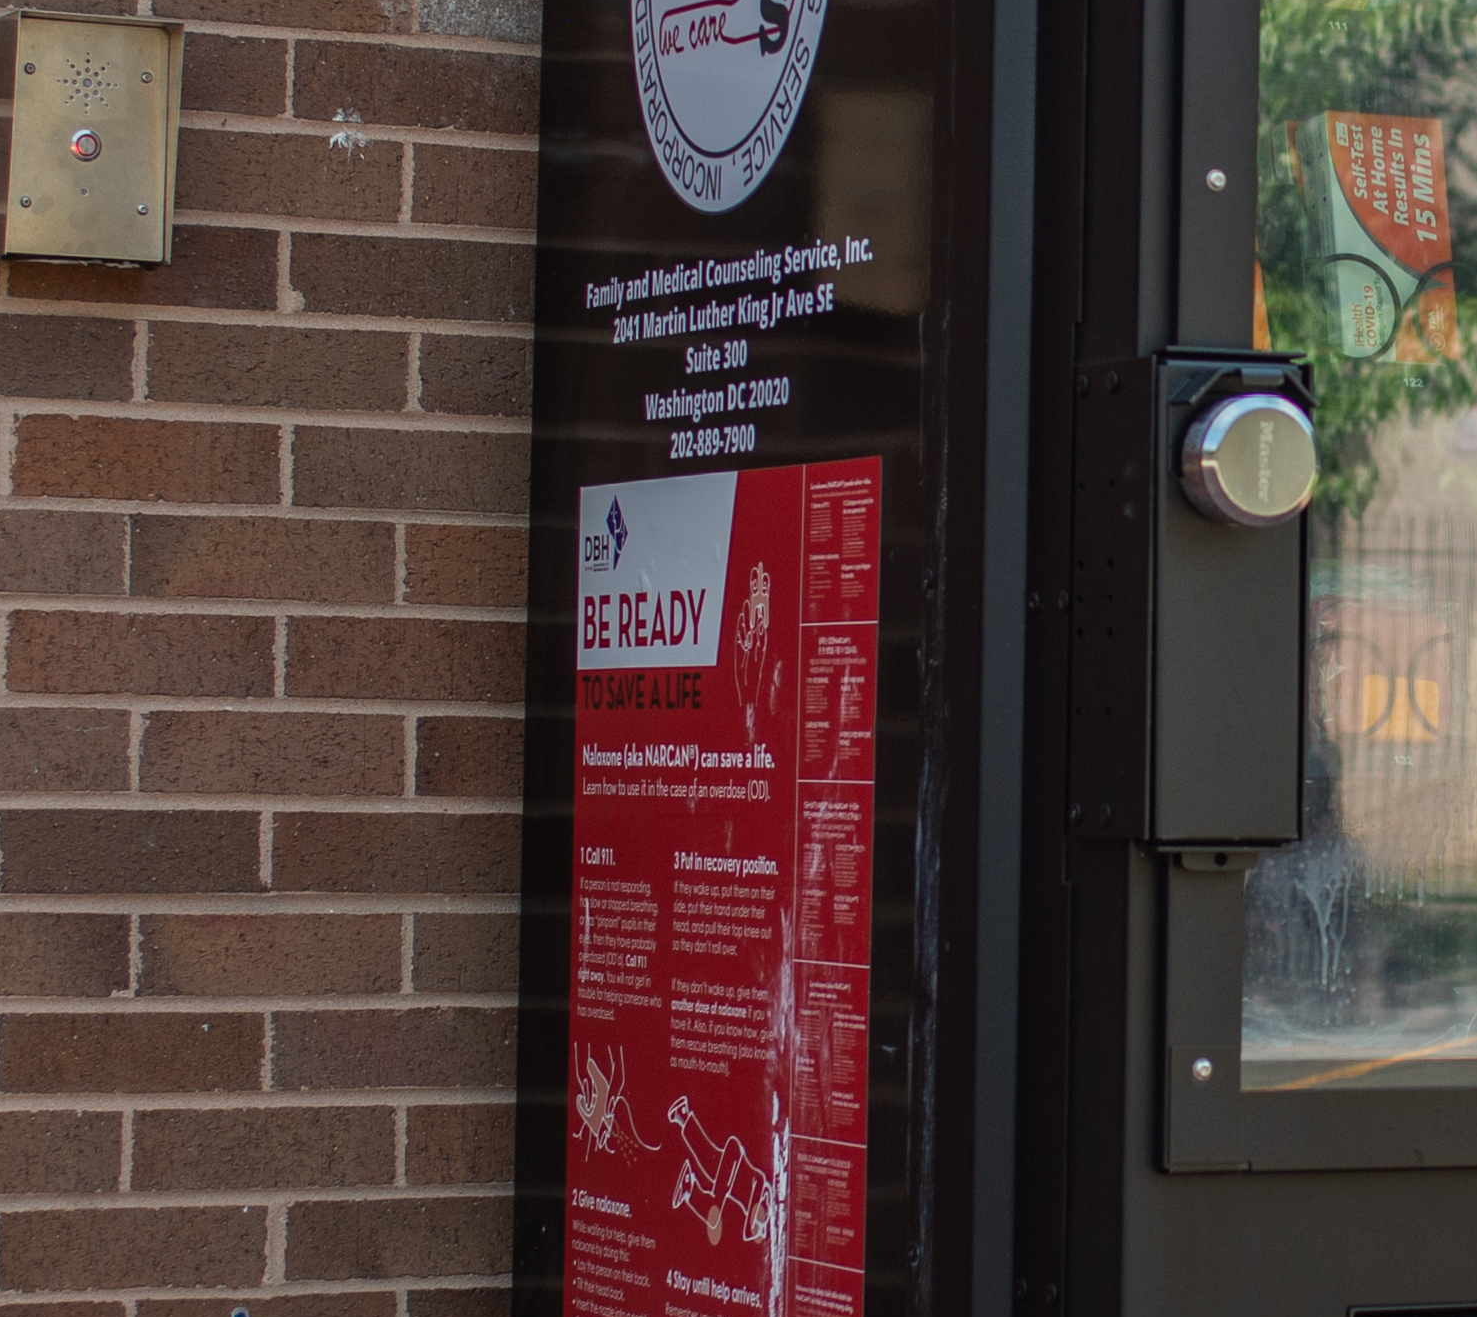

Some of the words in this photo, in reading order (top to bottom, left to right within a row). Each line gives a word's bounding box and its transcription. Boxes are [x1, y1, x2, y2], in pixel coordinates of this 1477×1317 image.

[688, 11, 727, 50] care
[1389, 128, 1402, 148] In
[1350, 124, 1368, 200] Self-Test
[1370, 126, 1389, 190] Home
[1412, 133, 1435, 204] Mins
[1373, 193, 1389, 215] At
[1390, 151, 1410, 226] Results
[1416, 208, 1438, 241] 15
[586, 276, 625, 311] Family
[626, 270, 649, 301] and
[651, 260, 703, 297] Medical
[705, 248, 781, 284] Counseling
[783, 238, 842, 271] Service,
[845, 235, 873, 264] Inc.
[613, 315, 640, 344] 2041
[643, 306, 686, 339] Martin
[689, 300, 736, 332] Luther
[737, 293, 769, 330] King
[769, 291, 784, 328] Jr
[785, 289, 813, 318] Ave
[816, 283, 834, 312] SE
[1363, 285, 1377, 348] COVID-19
[686, 343, 721, 374] Suite
[723, 339, 748, 368] 300
[644, 388, 724, 423] Washington
[727, 382, 746, 411] DC
[748, 376, 790, 408] 20020
[670, 423, 756, 460] 202-889-7900
[1257, 420, 1274, 503] Master
[584, 534, 610, 562] DBH
[582, 593, 612, 650] BE
[618, 588, 707, 648] READY
[581, 674, 604, 710] TO
[607, 673, 645, 710] SAVE
[649, 673, 662, 710] A
[665, 672, 702, 709] LIFE
[582, 743, 622, 767] Naloxone
[624, 742, 643, 770] (aka
[700, 751, 719, 768] can
[720, 751, 743, 769] save
[745, 752, 752, 769] a
[753, 743, 775, 769] life.
[580, 846, 584, 864] 1
[586, 846, 600, 865] Call
[601, 847, 616, 866] 911.
[674, 851, 680, 870] 3
[680, 851, 694, 870] Put
[694, 851, 702, 871] in
[703, 857, 742, 877] recovery
[742, 855, 779, 878] position.
[572, 1188, 578, 1206] 2
[578, 1189, 595, 1210] Give
[595, 1194, 632, 1218] naloxone.
[666, 1268, 672, 1287] 4
[673, 1270, 692, 1296] Stay
[692, 1276, 710, 1296] until
[711, 1278, 730, 1305] help
[731, 1285, 763, 1309] arrives.
